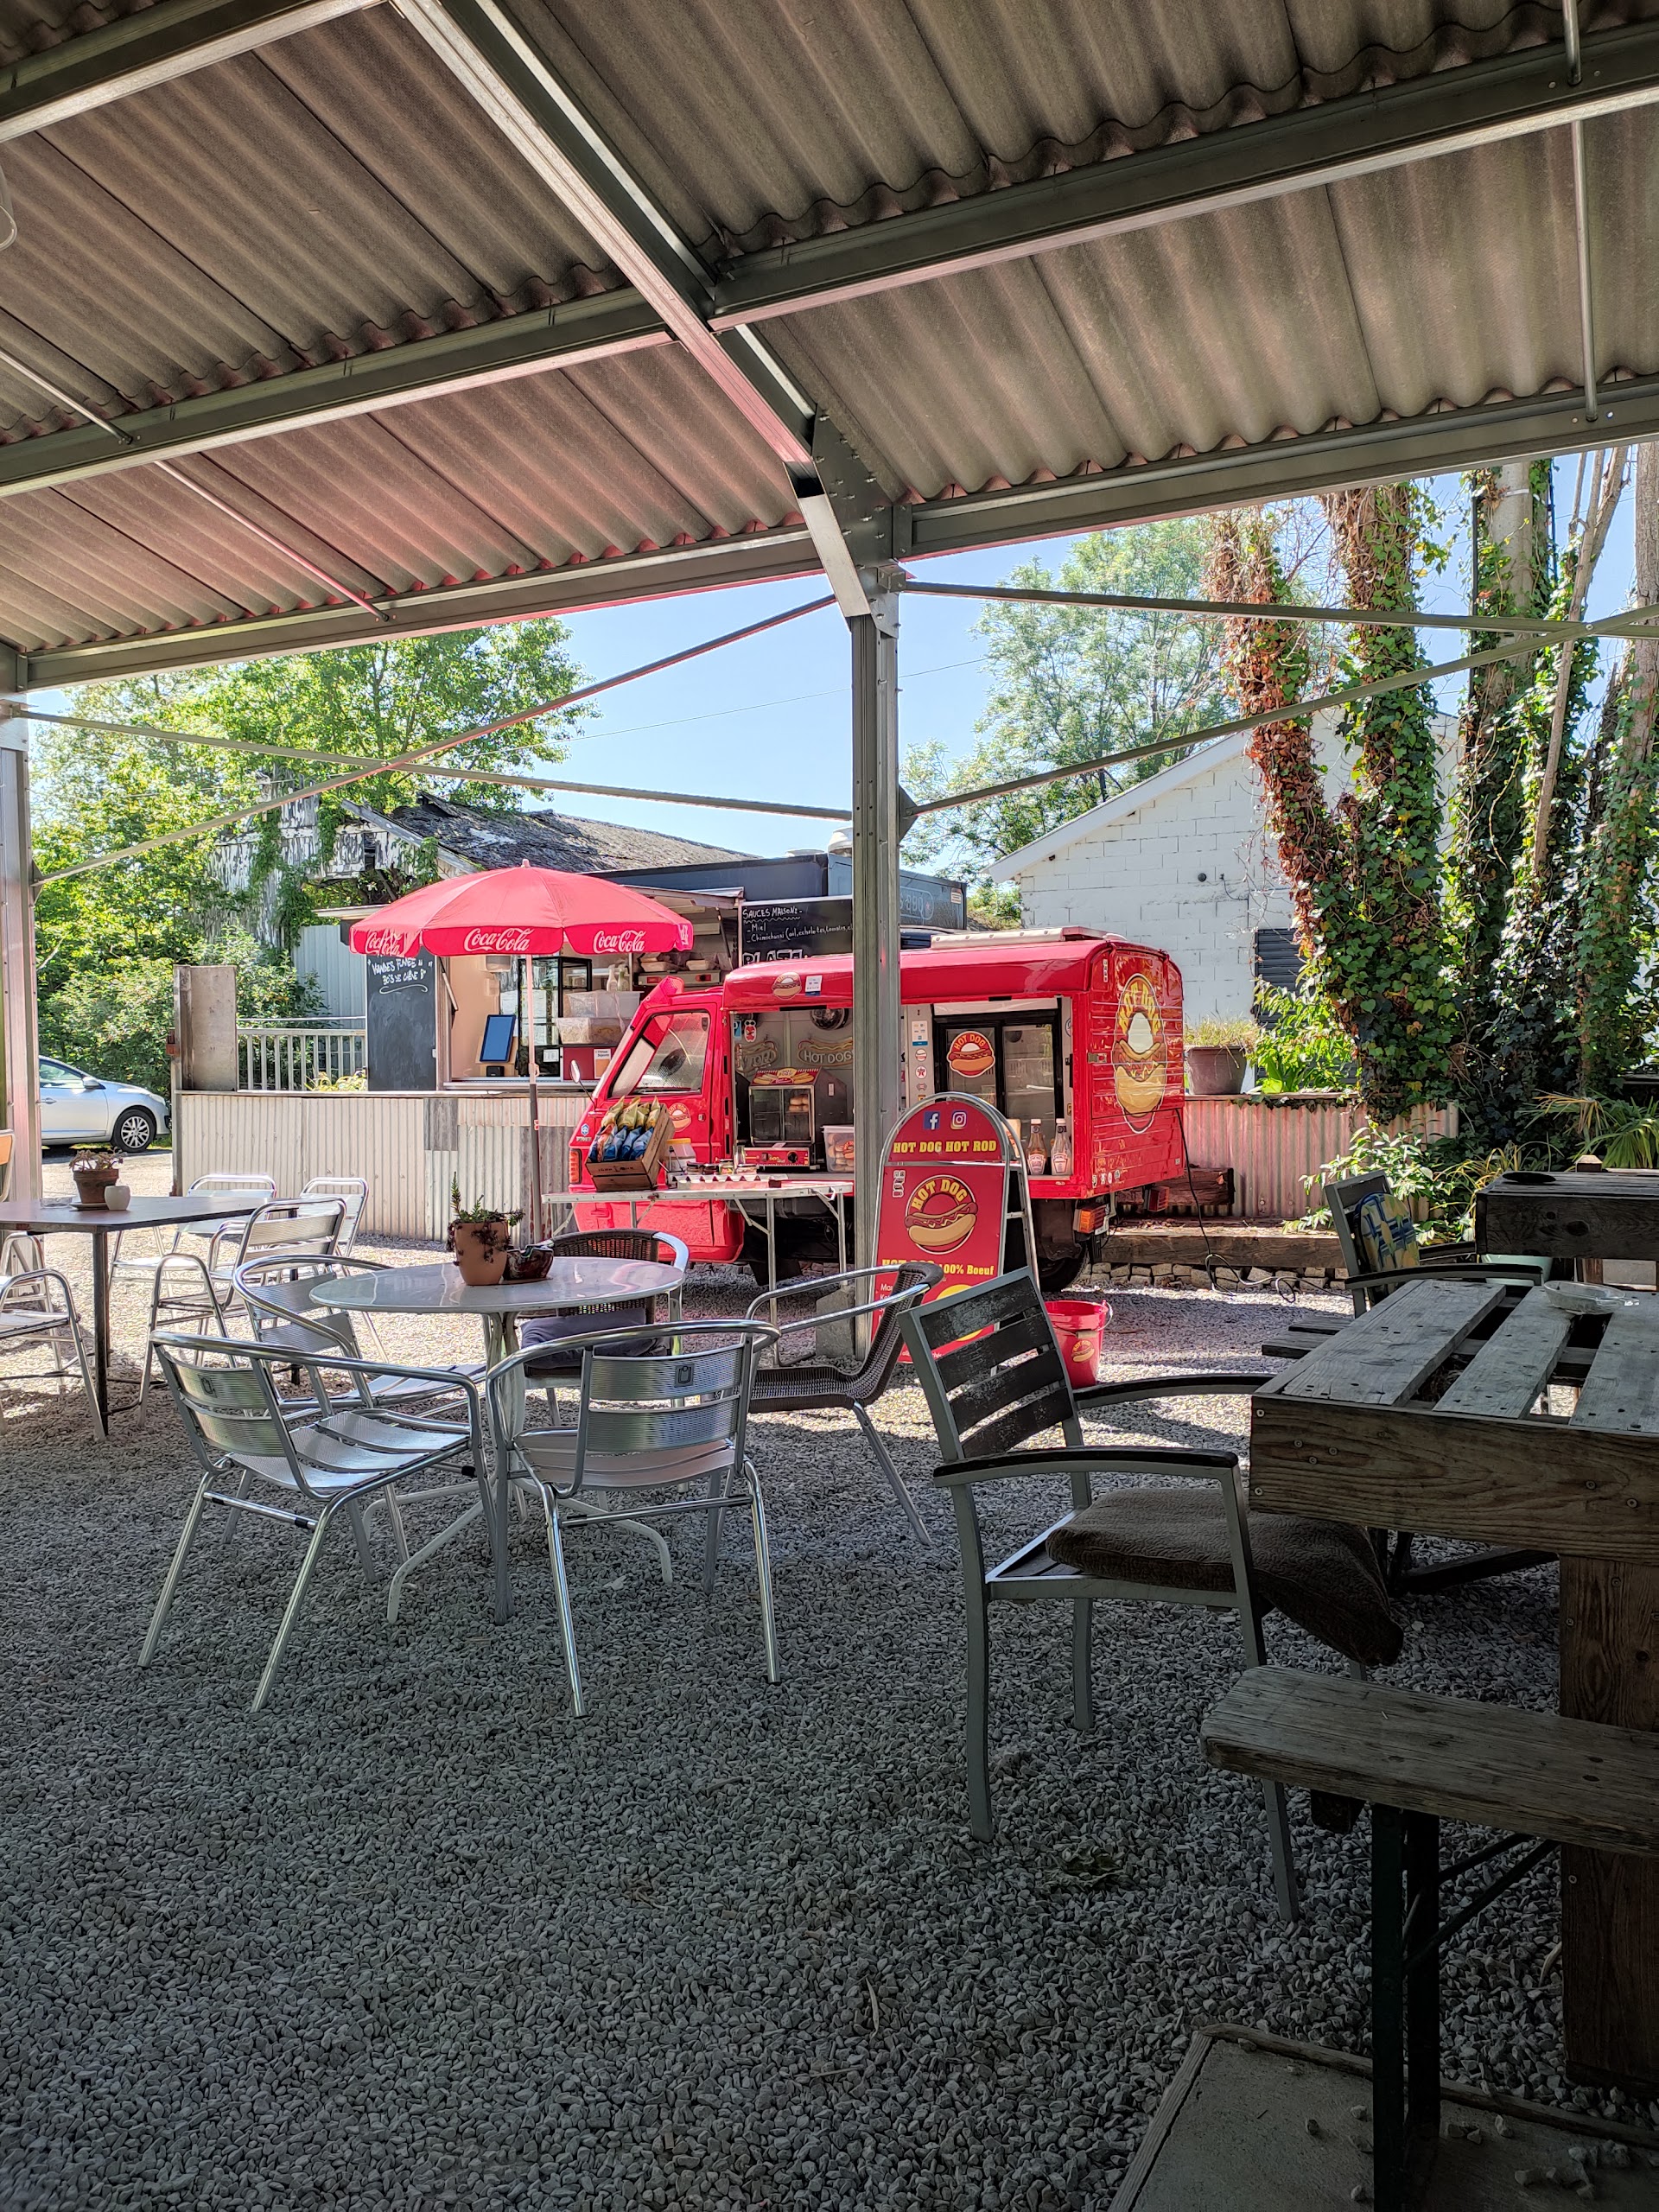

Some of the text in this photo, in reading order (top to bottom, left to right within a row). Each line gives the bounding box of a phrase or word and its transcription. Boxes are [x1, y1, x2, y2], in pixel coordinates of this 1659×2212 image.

[743, 909, 770, 919] SAUCES
[464, 927, 535, 952] Coca-Cola
[594, 930, 646, 953] Coca-Cola
[953, 1033, 987, 1051] HOT DOG
[804, 1050, 826, 1064] HOT
[893, 1140, 997, 1154] HOT DOG HOT ROD
[911, 1179, 968, 1211] HOT DOG
[967, 1264, 995, 1275] Boeuf
